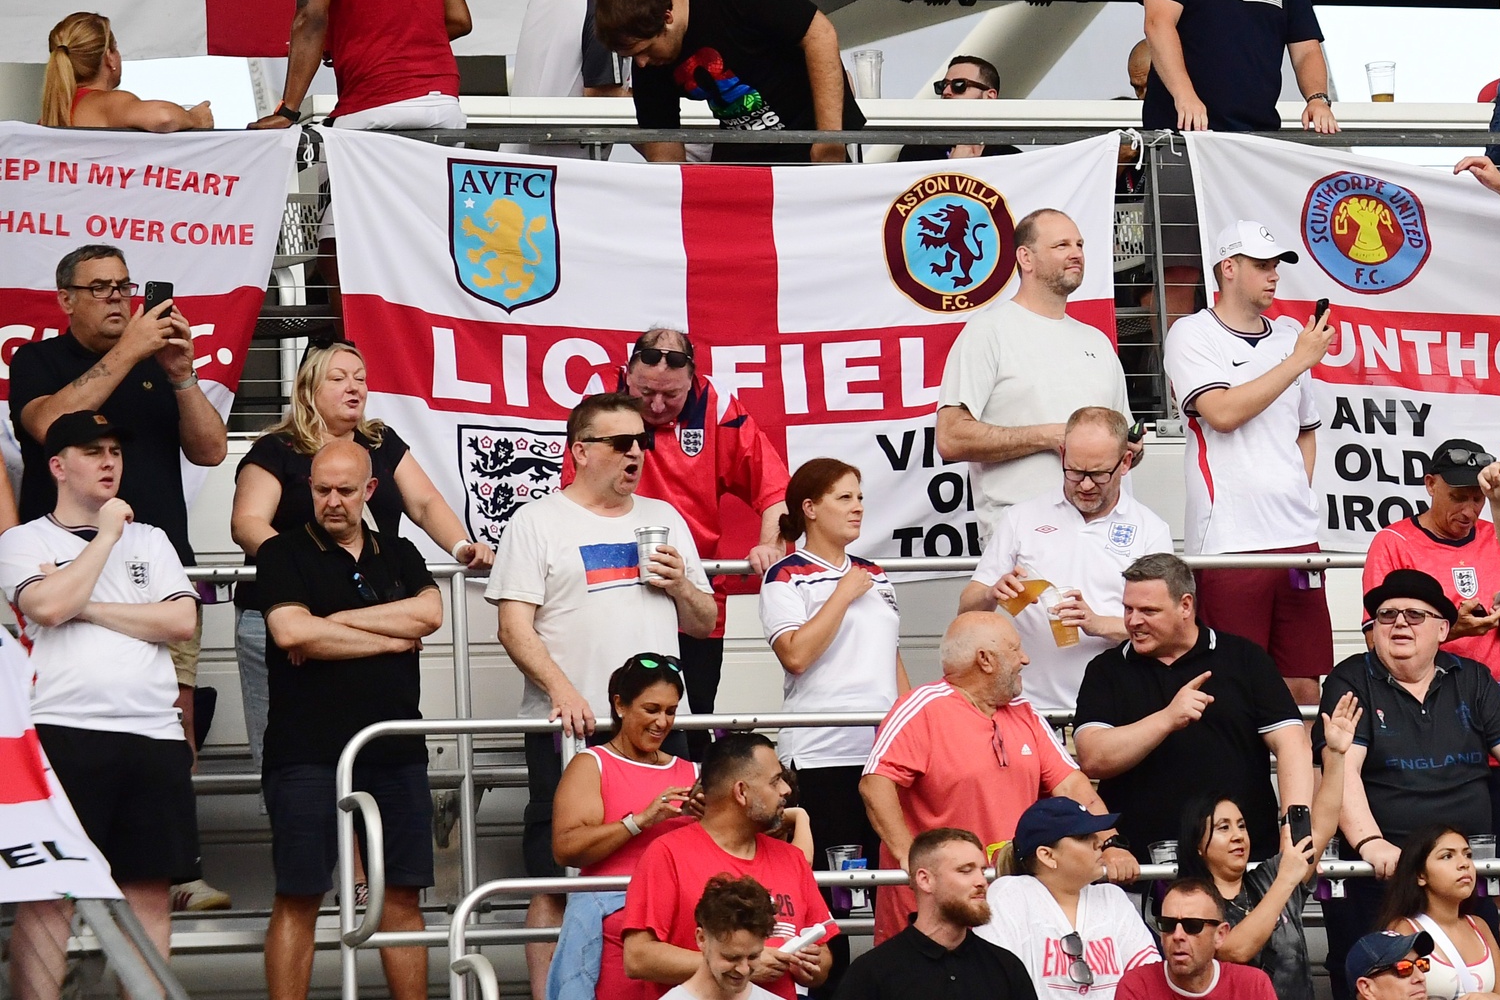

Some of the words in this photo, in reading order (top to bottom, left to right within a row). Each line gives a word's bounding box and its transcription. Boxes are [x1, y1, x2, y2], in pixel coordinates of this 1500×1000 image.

[0, 158, 40, 181] EP
[48, 161, 78, 185] IN
[87, 163, 136, 190] MY
[142, 164, 240, 197] HEART
[458, 167, 547, 199] AVFC
[895, 175, 951, 217] ASTON
[955, 176, 999, 210] VILLA
[86, 214, 165, 243] OVER
[170, 221, 255, 246] COME
[1310, 176, 1387, 243] SCUNTHORPE
[1389, 190, 1424, 249] UNITED
[1355, 268, 1385, 285] F.C.
[942, 295, 974, 310] F.C.
[431, 326, 940, 415] LICFIEL
[1330, 396, 1432, 437] ANY
[1334, 443, 1433, 486] OLD
[927, 471, 975, 514] O
[1326, 493, 1433, 533] IRO
[1386, 751, 1484, 770] ENGLAND
[1042, 936, 1120, 977] ENAND
